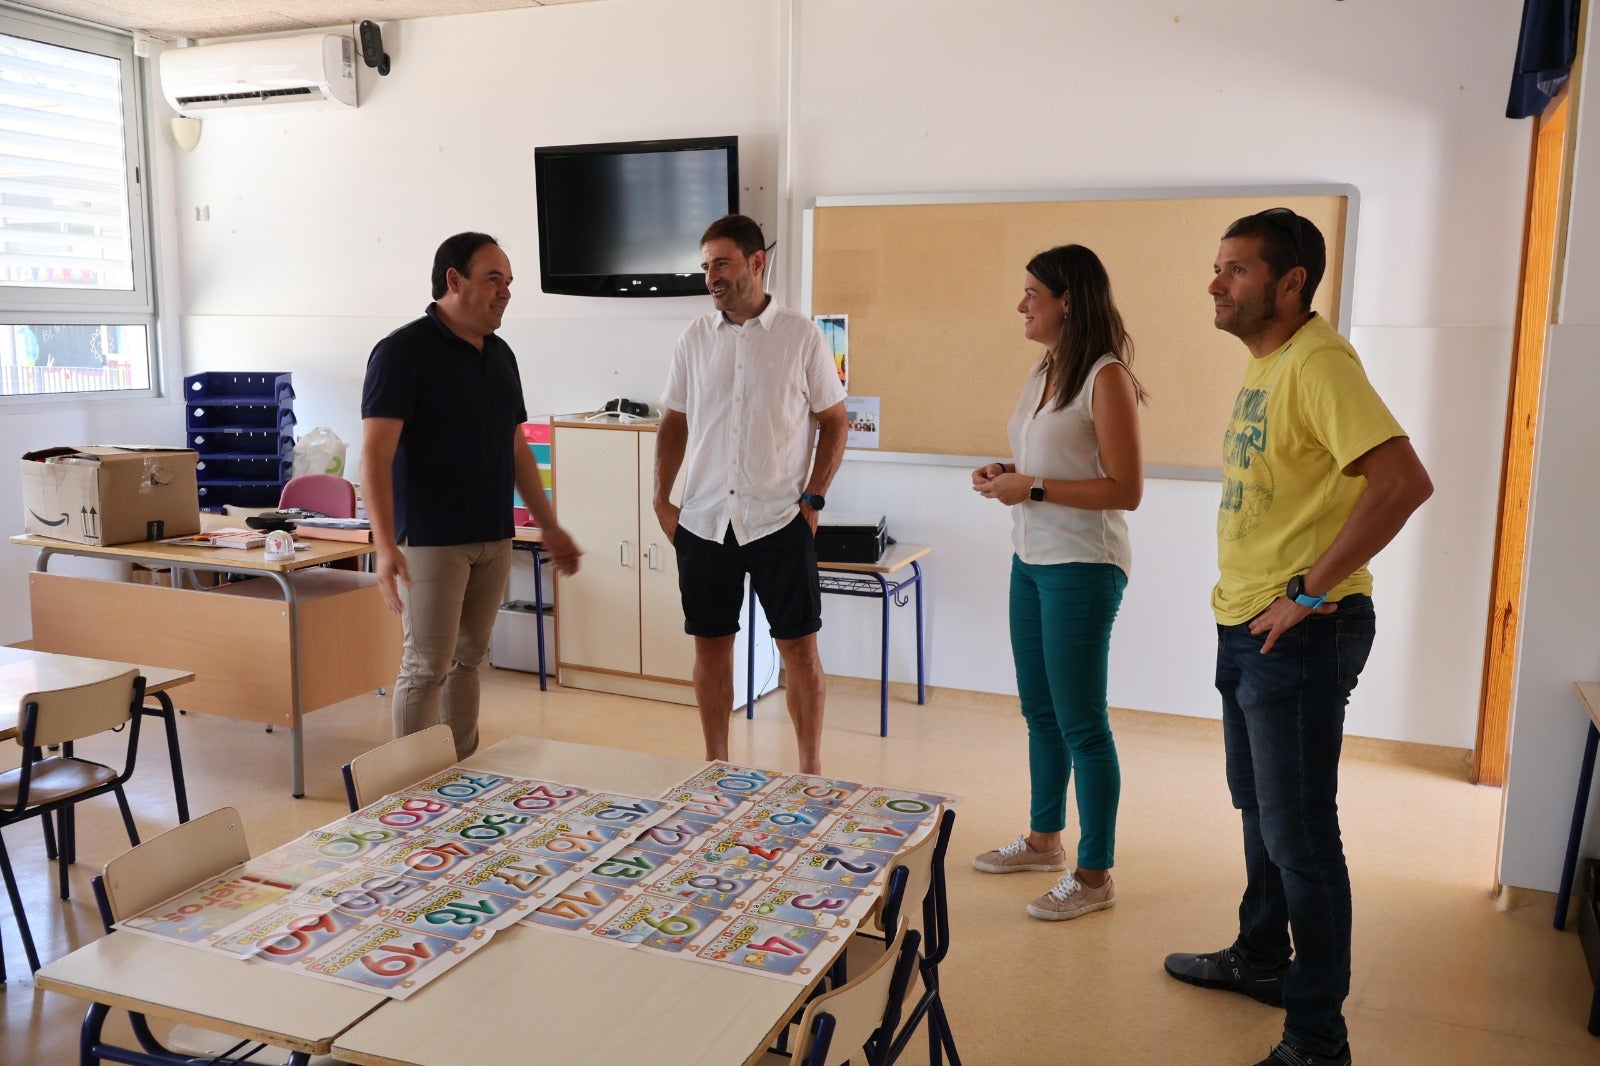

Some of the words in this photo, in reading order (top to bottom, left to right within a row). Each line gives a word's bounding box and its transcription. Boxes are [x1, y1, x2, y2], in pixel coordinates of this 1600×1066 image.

[438, 776, 500, 797] 70
[717, 772, 768, 791] 10
[803, 785, 848, 799] 5
[513, 785, 573, 809] 20
[886, 799, 932, 813] 0
[379, 799, 447, 826] 80
[595, 803, 649, 822] 15
[770, 813, 813, 825] 6
[460, 814, 529, 839] 30
[636, 825, 696, 846] 12
[857, 826, 905, 837] 1
[319, 830, 394, 857] 90
[545, 830, 604, 852] 16
[734, 843, 784, 860] 7
[405, 843, 471, 871] 40
[592, 856, 653, 878] 13
[822, 857, 877, 873] 2
[494, 865, 552, 891] 17
[688, 875, 738, 892] 8
[331, 876, 418, 910] 50
[791, 894, 845, 910] 3
[425, 900, 497, 925] 18
[536, 891, 604, 919] 14
[256, 913, 337, 955] 60
[643, 916, 699, 935] 9
[723, 925, 758, 952] cuatro
[746, 936, 805, 956] 4
[323, 929, 402, 974] diecinueve
[360, 942, 433, 976] 19
